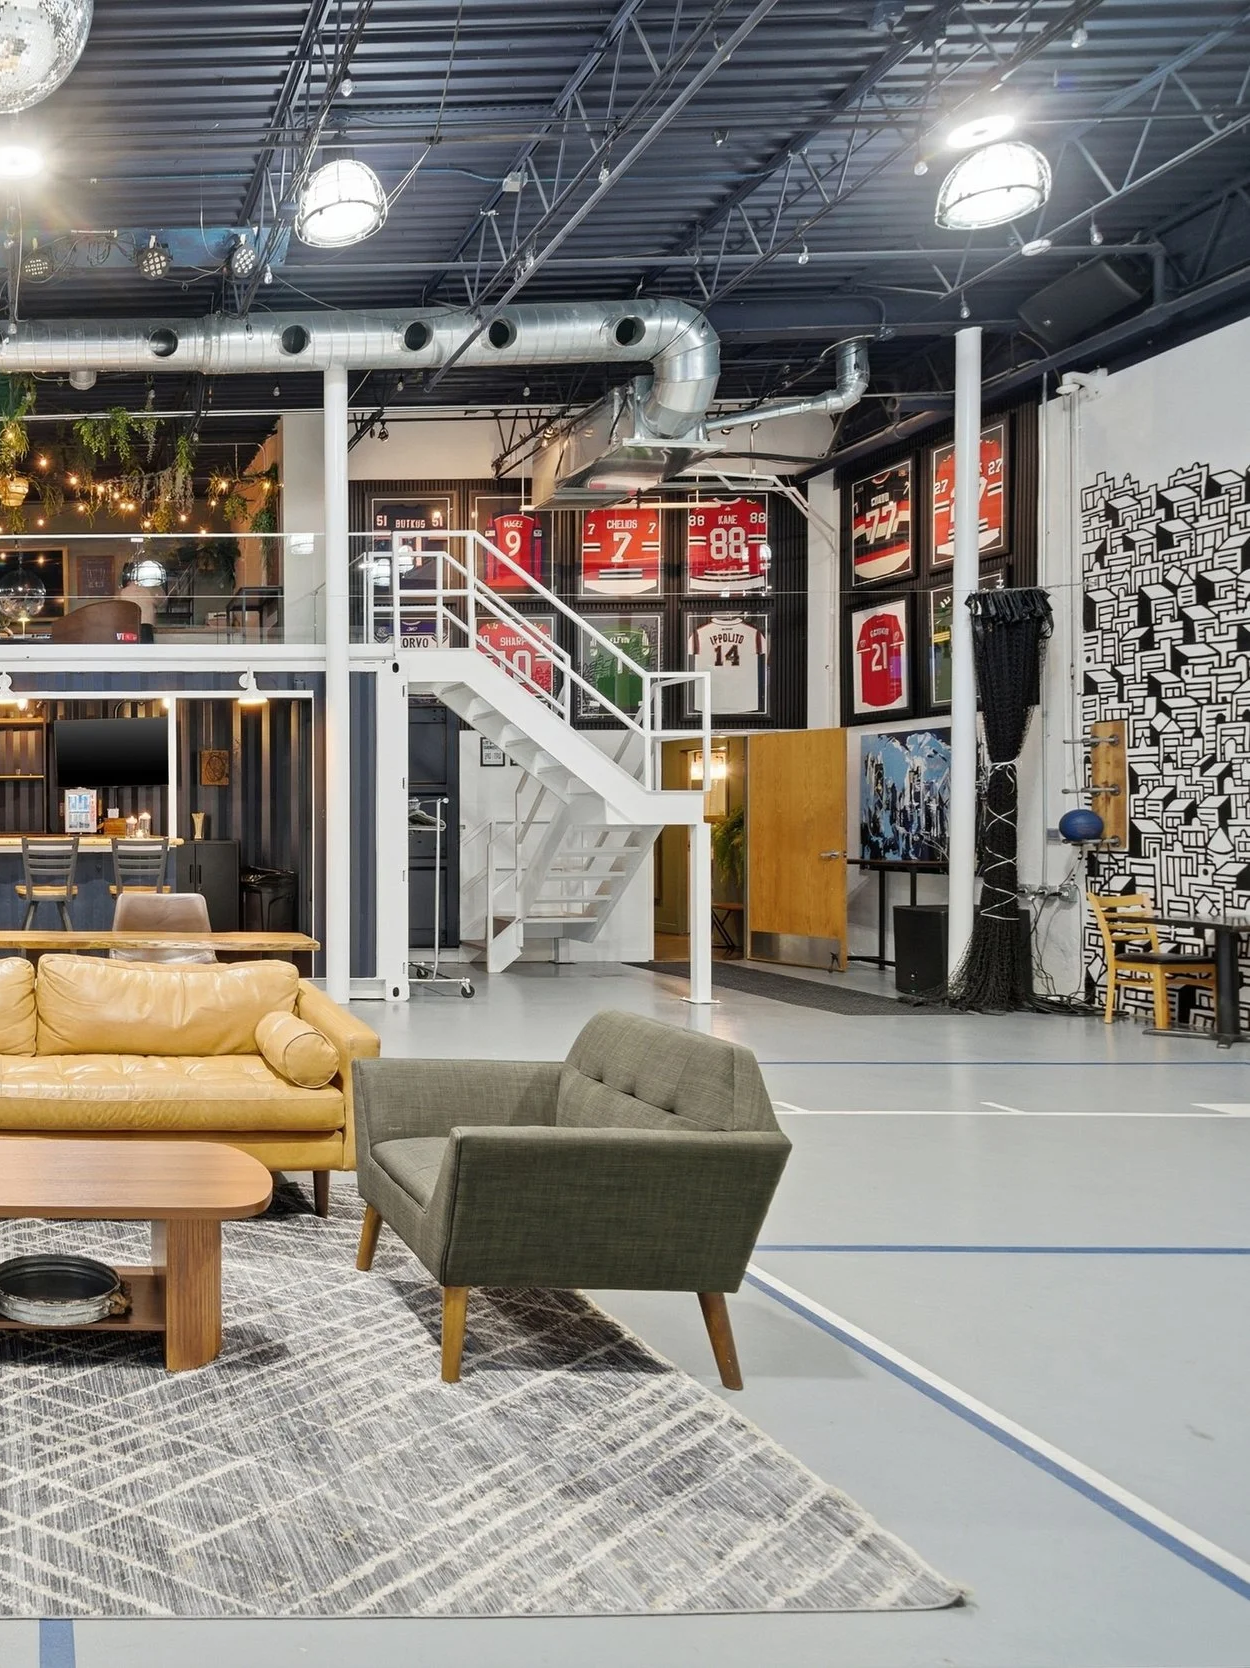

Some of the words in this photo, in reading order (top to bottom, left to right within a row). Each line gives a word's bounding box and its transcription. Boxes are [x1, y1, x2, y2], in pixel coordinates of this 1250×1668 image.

[988, 458, 1002, 475] 27
[935, 479, 949, 495] 27
[377, 515, 387, 526] 51
[395, 519, 426, 528] BUTKUS
[588, 523, 595, 535] 7
[606, 519, 637, 529] CHELIOS
[648, 522, 656, 534] 7
[689, 515, 705, 526] 88
[718, 515, 738, 525] KANE
[750, 512, 766, 523] 88
[866, 501, 897, 544] 77
[505, 530, 521, 557] 9
[611, 532, 632, 562] 7
[710, 527, 746, 560] 88
[401, 638, 429, 648] ORVO
[710, 633, 744, 645] IPPOLITO
[714, 645, 740, 666] 14
[872, 642, 887, 671] 21
